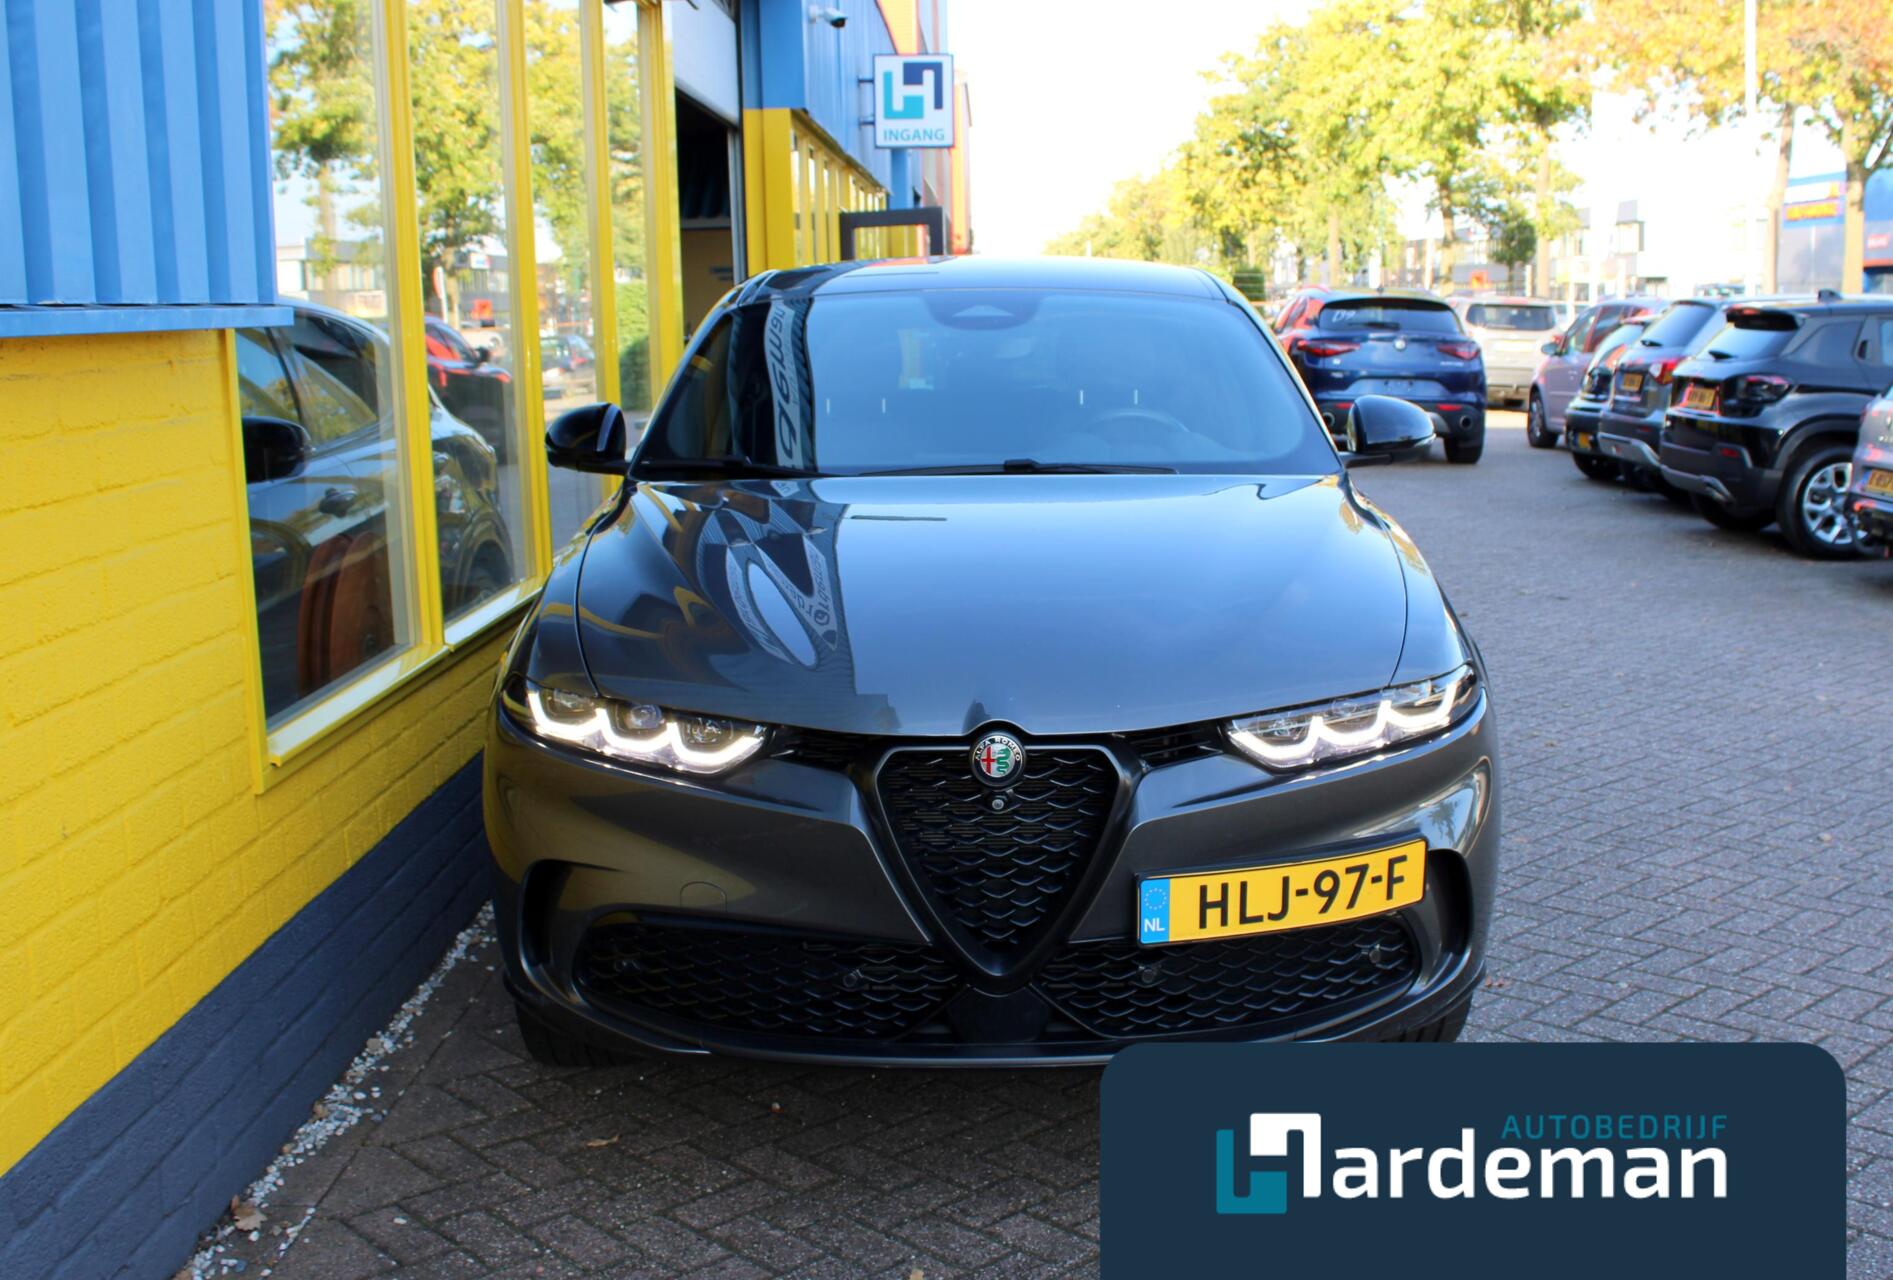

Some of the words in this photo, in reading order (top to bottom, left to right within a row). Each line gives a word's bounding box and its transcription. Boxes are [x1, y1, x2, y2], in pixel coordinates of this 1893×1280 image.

[883, 128, 945, 141] INGANG
[975, 740, 992, 761] ALFA
[994, 737, 1021, 761] ROMEO
[1144, 917, 1165, 932] NL
[1199, 854, 1408, 929] HLJ-97-F
